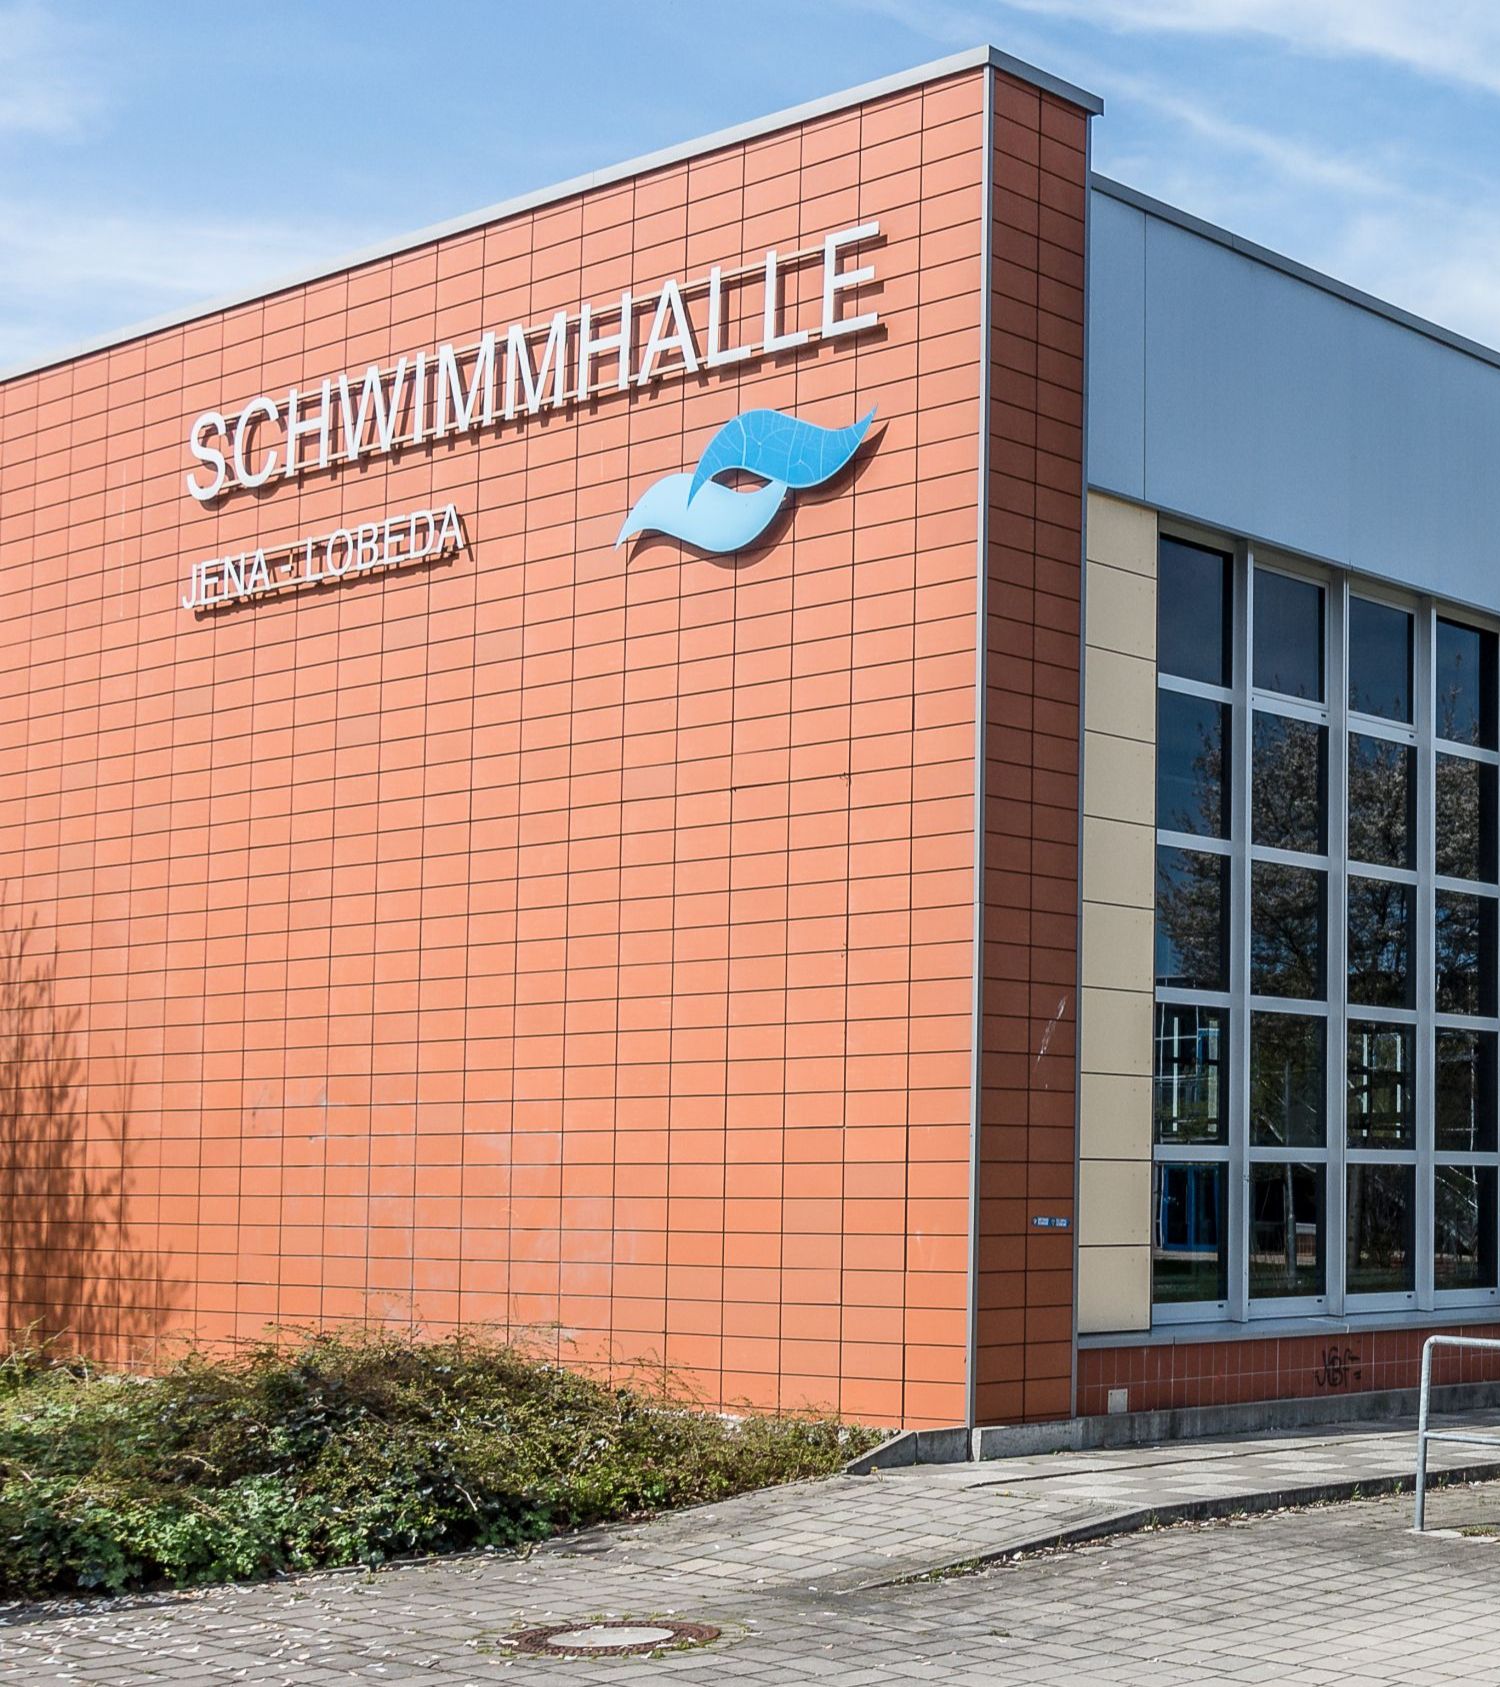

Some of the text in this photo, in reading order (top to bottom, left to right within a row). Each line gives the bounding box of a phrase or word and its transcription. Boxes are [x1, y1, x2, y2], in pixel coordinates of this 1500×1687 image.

[186, 221, 880, 501] SCHWIMMHALLE
[182, 548, 272, 610] JENA
[304, 503, 465, 583] LOBEDA
